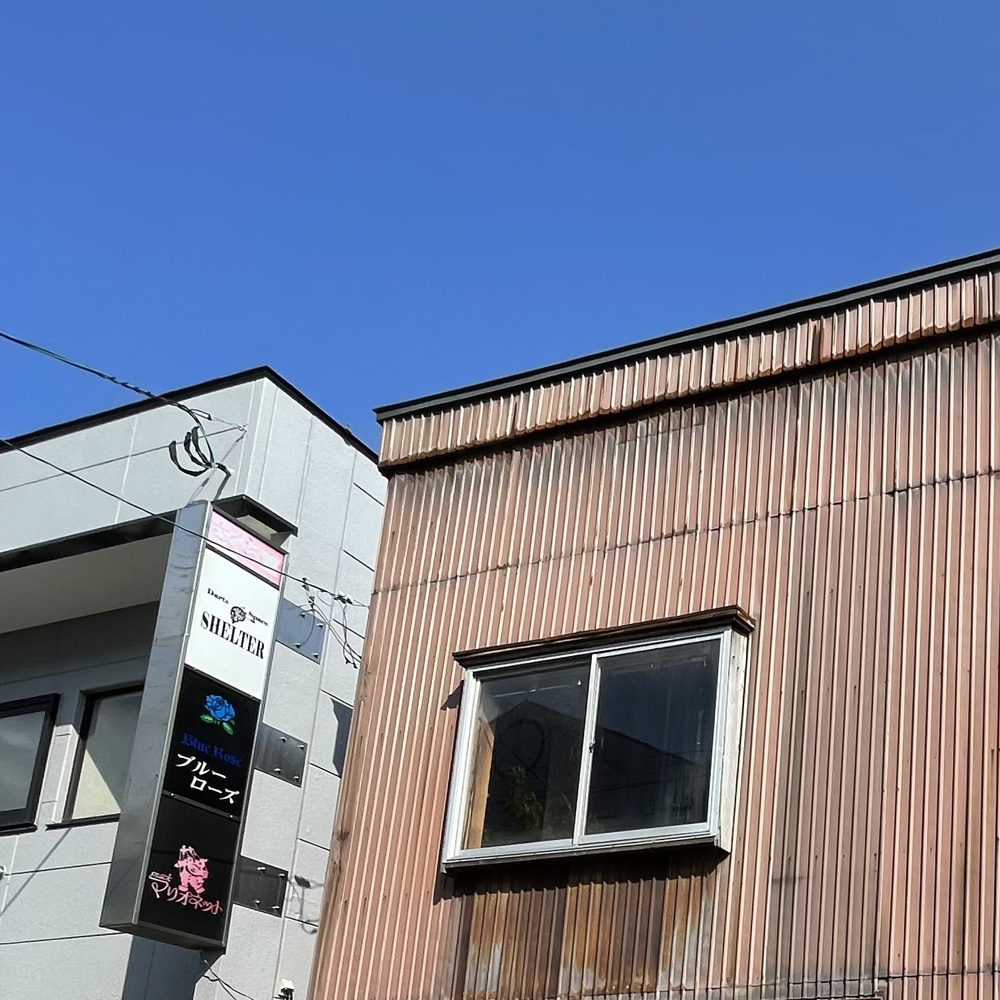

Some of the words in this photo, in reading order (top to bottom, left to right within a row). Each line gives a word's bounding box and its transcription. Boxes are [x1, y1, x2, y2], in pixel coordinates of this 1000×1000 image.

[207, 587, 229, 605] Darts
[200, 610, 265, 660] SHELTER
[175, 753, 227, 779] ブルー
[181, 732, 211, 755] Blue
[212, 745, 242, 768] Rose
[190, 775, 240, 804] ローズ
[148, 876, 223, 915] マリオネット
